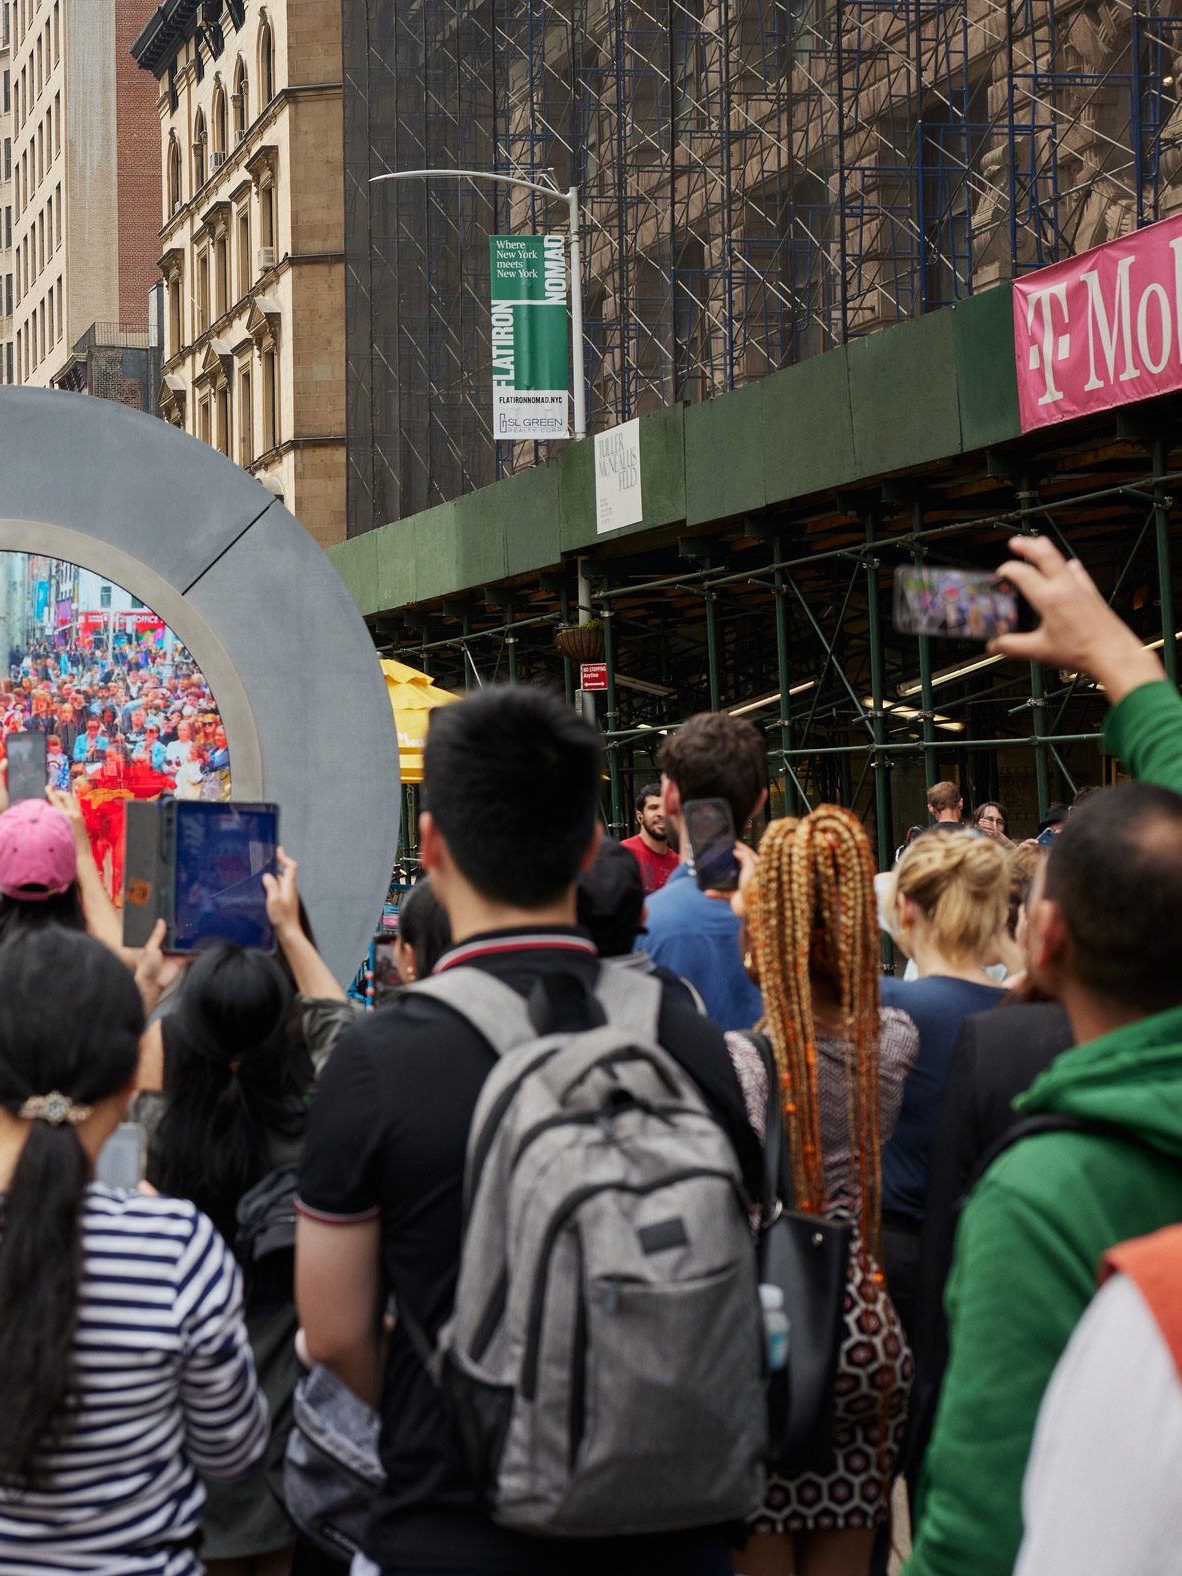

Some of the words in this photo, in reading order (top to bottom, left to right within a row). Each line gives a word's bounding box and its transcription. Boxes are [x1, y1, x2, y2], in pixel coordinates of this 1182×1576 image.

[496, 240, 526, 249] Where
[496, 250, 516, 259] New
[518, 250, 538, 259] York
[496, 261, 524, 269] meets
[497, 270, 516, 278] New
[518, 269, 538, 278] York
[543, 235, 567, 305] NOMAD
[491, 300, 515, 389] FLATIRON
[499, 396, 563, 404] FLATIRONNOMAD.NYC
[508, 418, 521, 427] SL
[522, 418, 563, 427] GREEN
